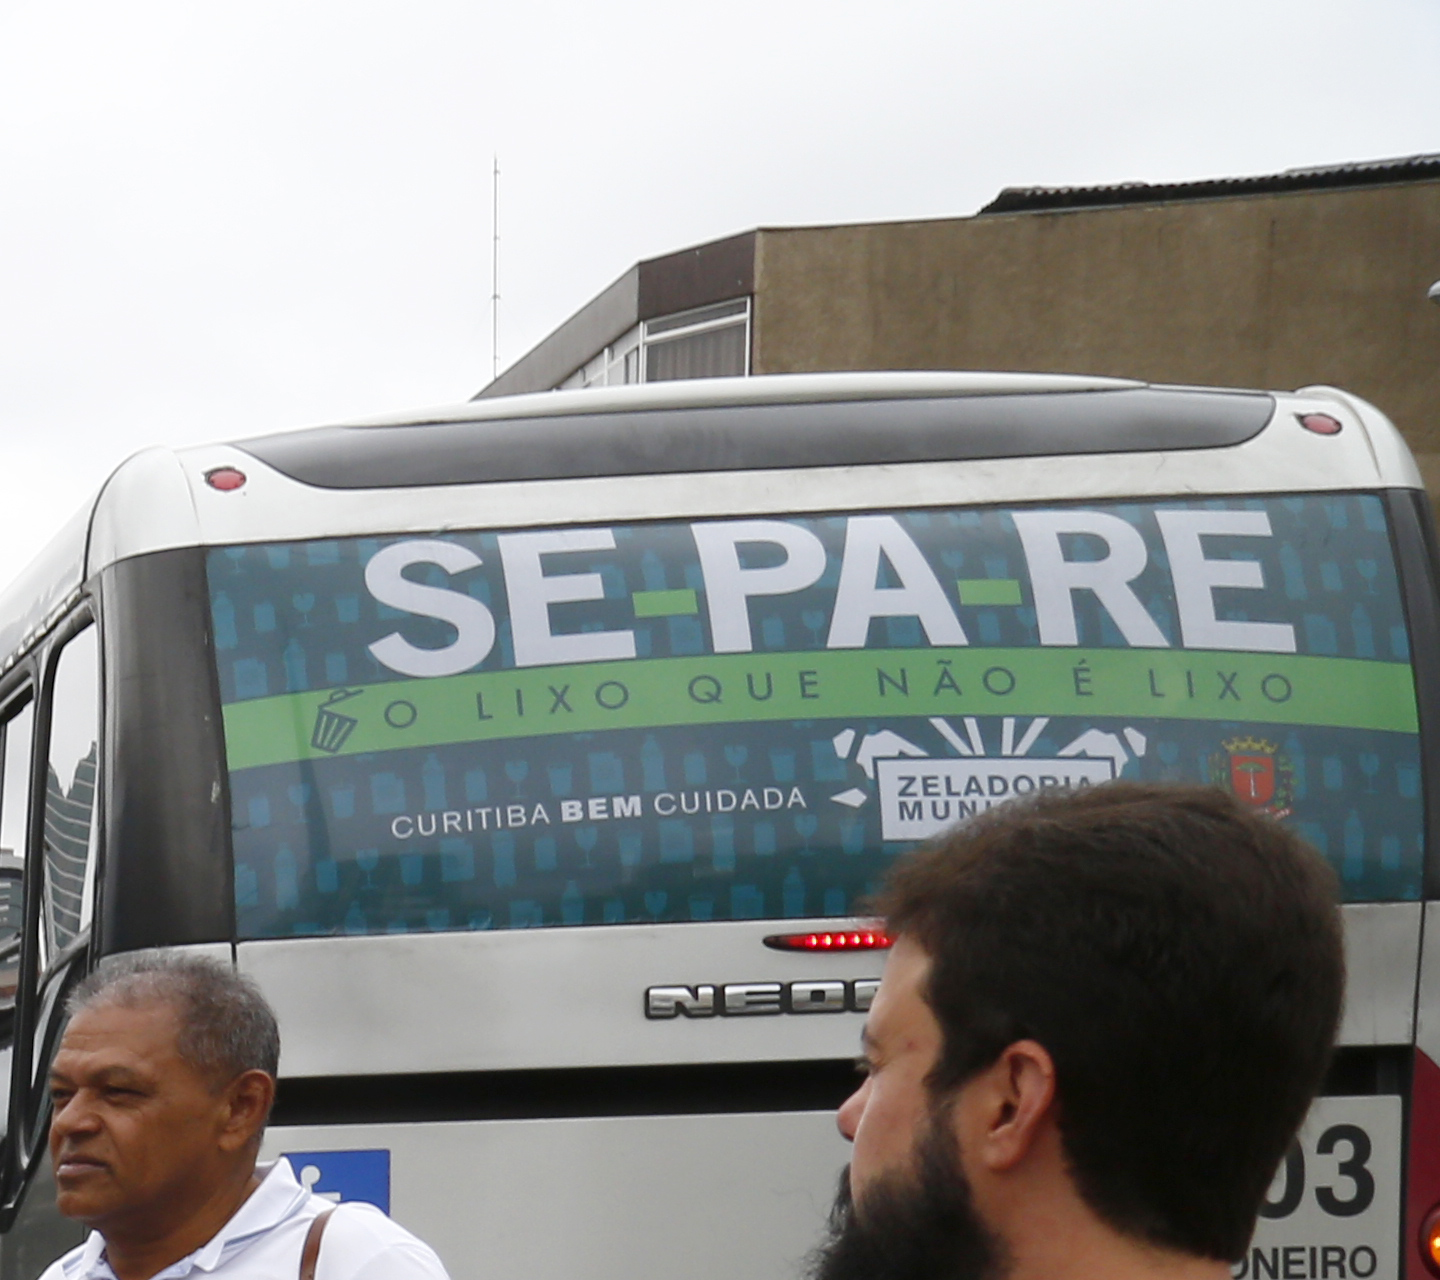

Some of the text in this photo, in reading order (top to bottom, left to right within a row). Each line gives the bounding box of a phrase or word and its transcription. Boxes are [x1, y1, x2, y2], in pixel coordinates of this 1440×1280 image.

[384, 658, 1293, 730] O LIXO QUE NÃO É LIXO
[391, 786, 808, 840] CURITIBA BEM CUIDADA
